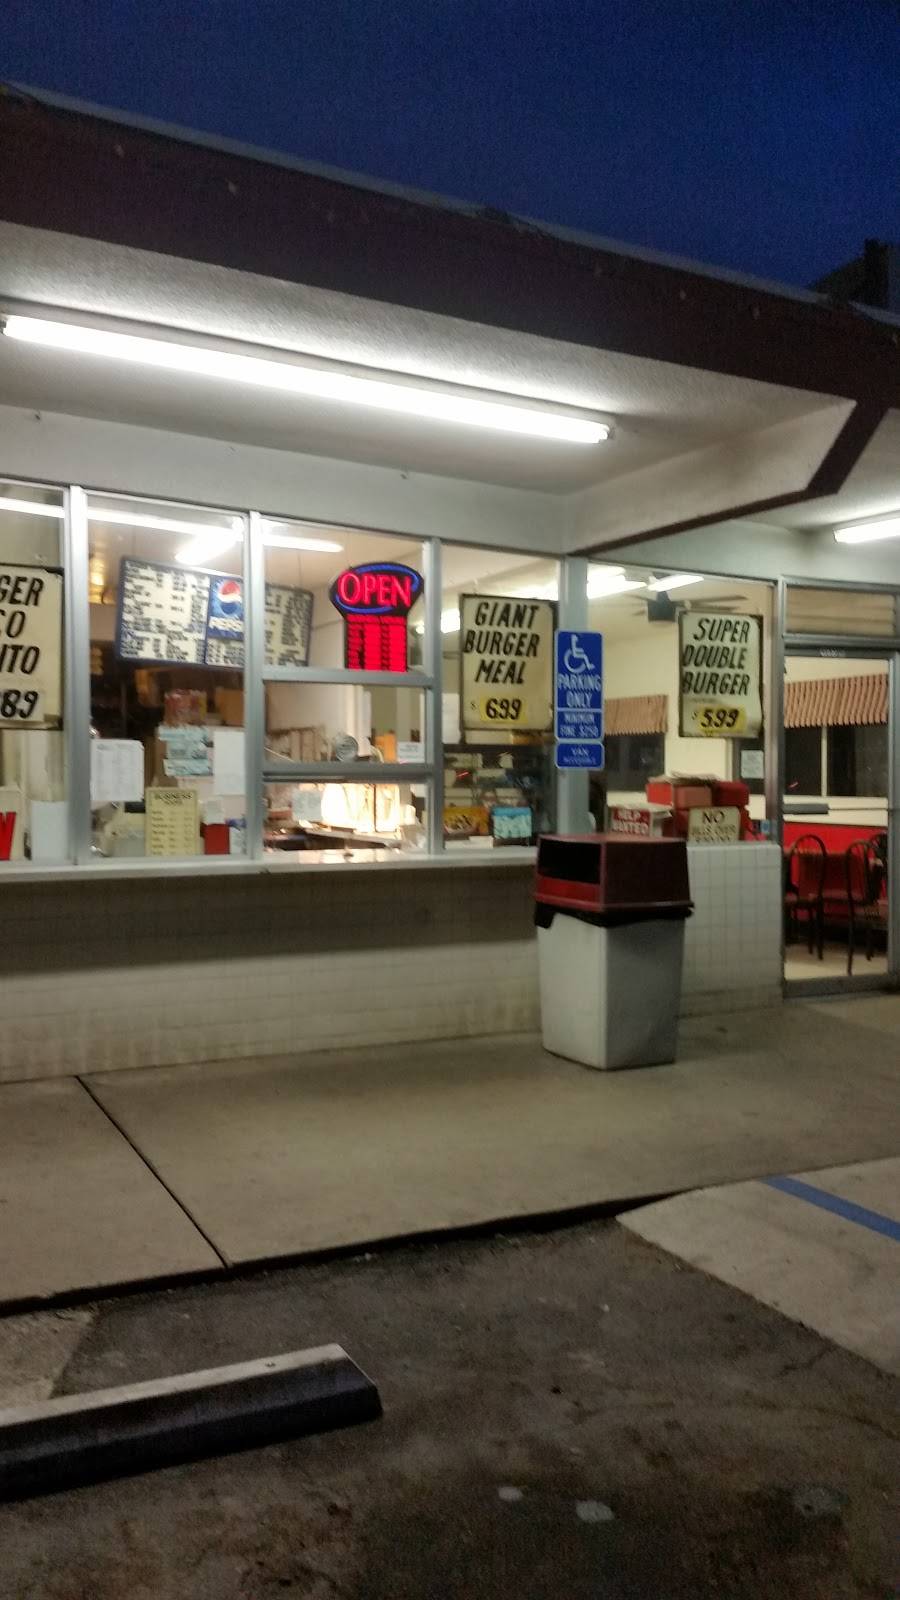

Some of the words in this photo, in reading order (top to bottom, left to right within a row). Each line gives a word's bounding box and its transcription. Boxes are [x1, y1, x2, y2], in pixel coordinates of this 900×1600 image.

[338, 571, 411, 606] OPEN
[475, 601, 539, 629] GIANT
[693, 618, 750, 643] SUPER
[462, 629, 540, 657] BURGER
[682, 644, 747, 669] DOUBLE
[475, 660, 526, 684] MEAL
[558, 673, 601, 690] PARKING
[682, 672, 750, 695] BURGER
[566, 691, 593, 707] ONLY
[702, 811, 726, 824] NO
